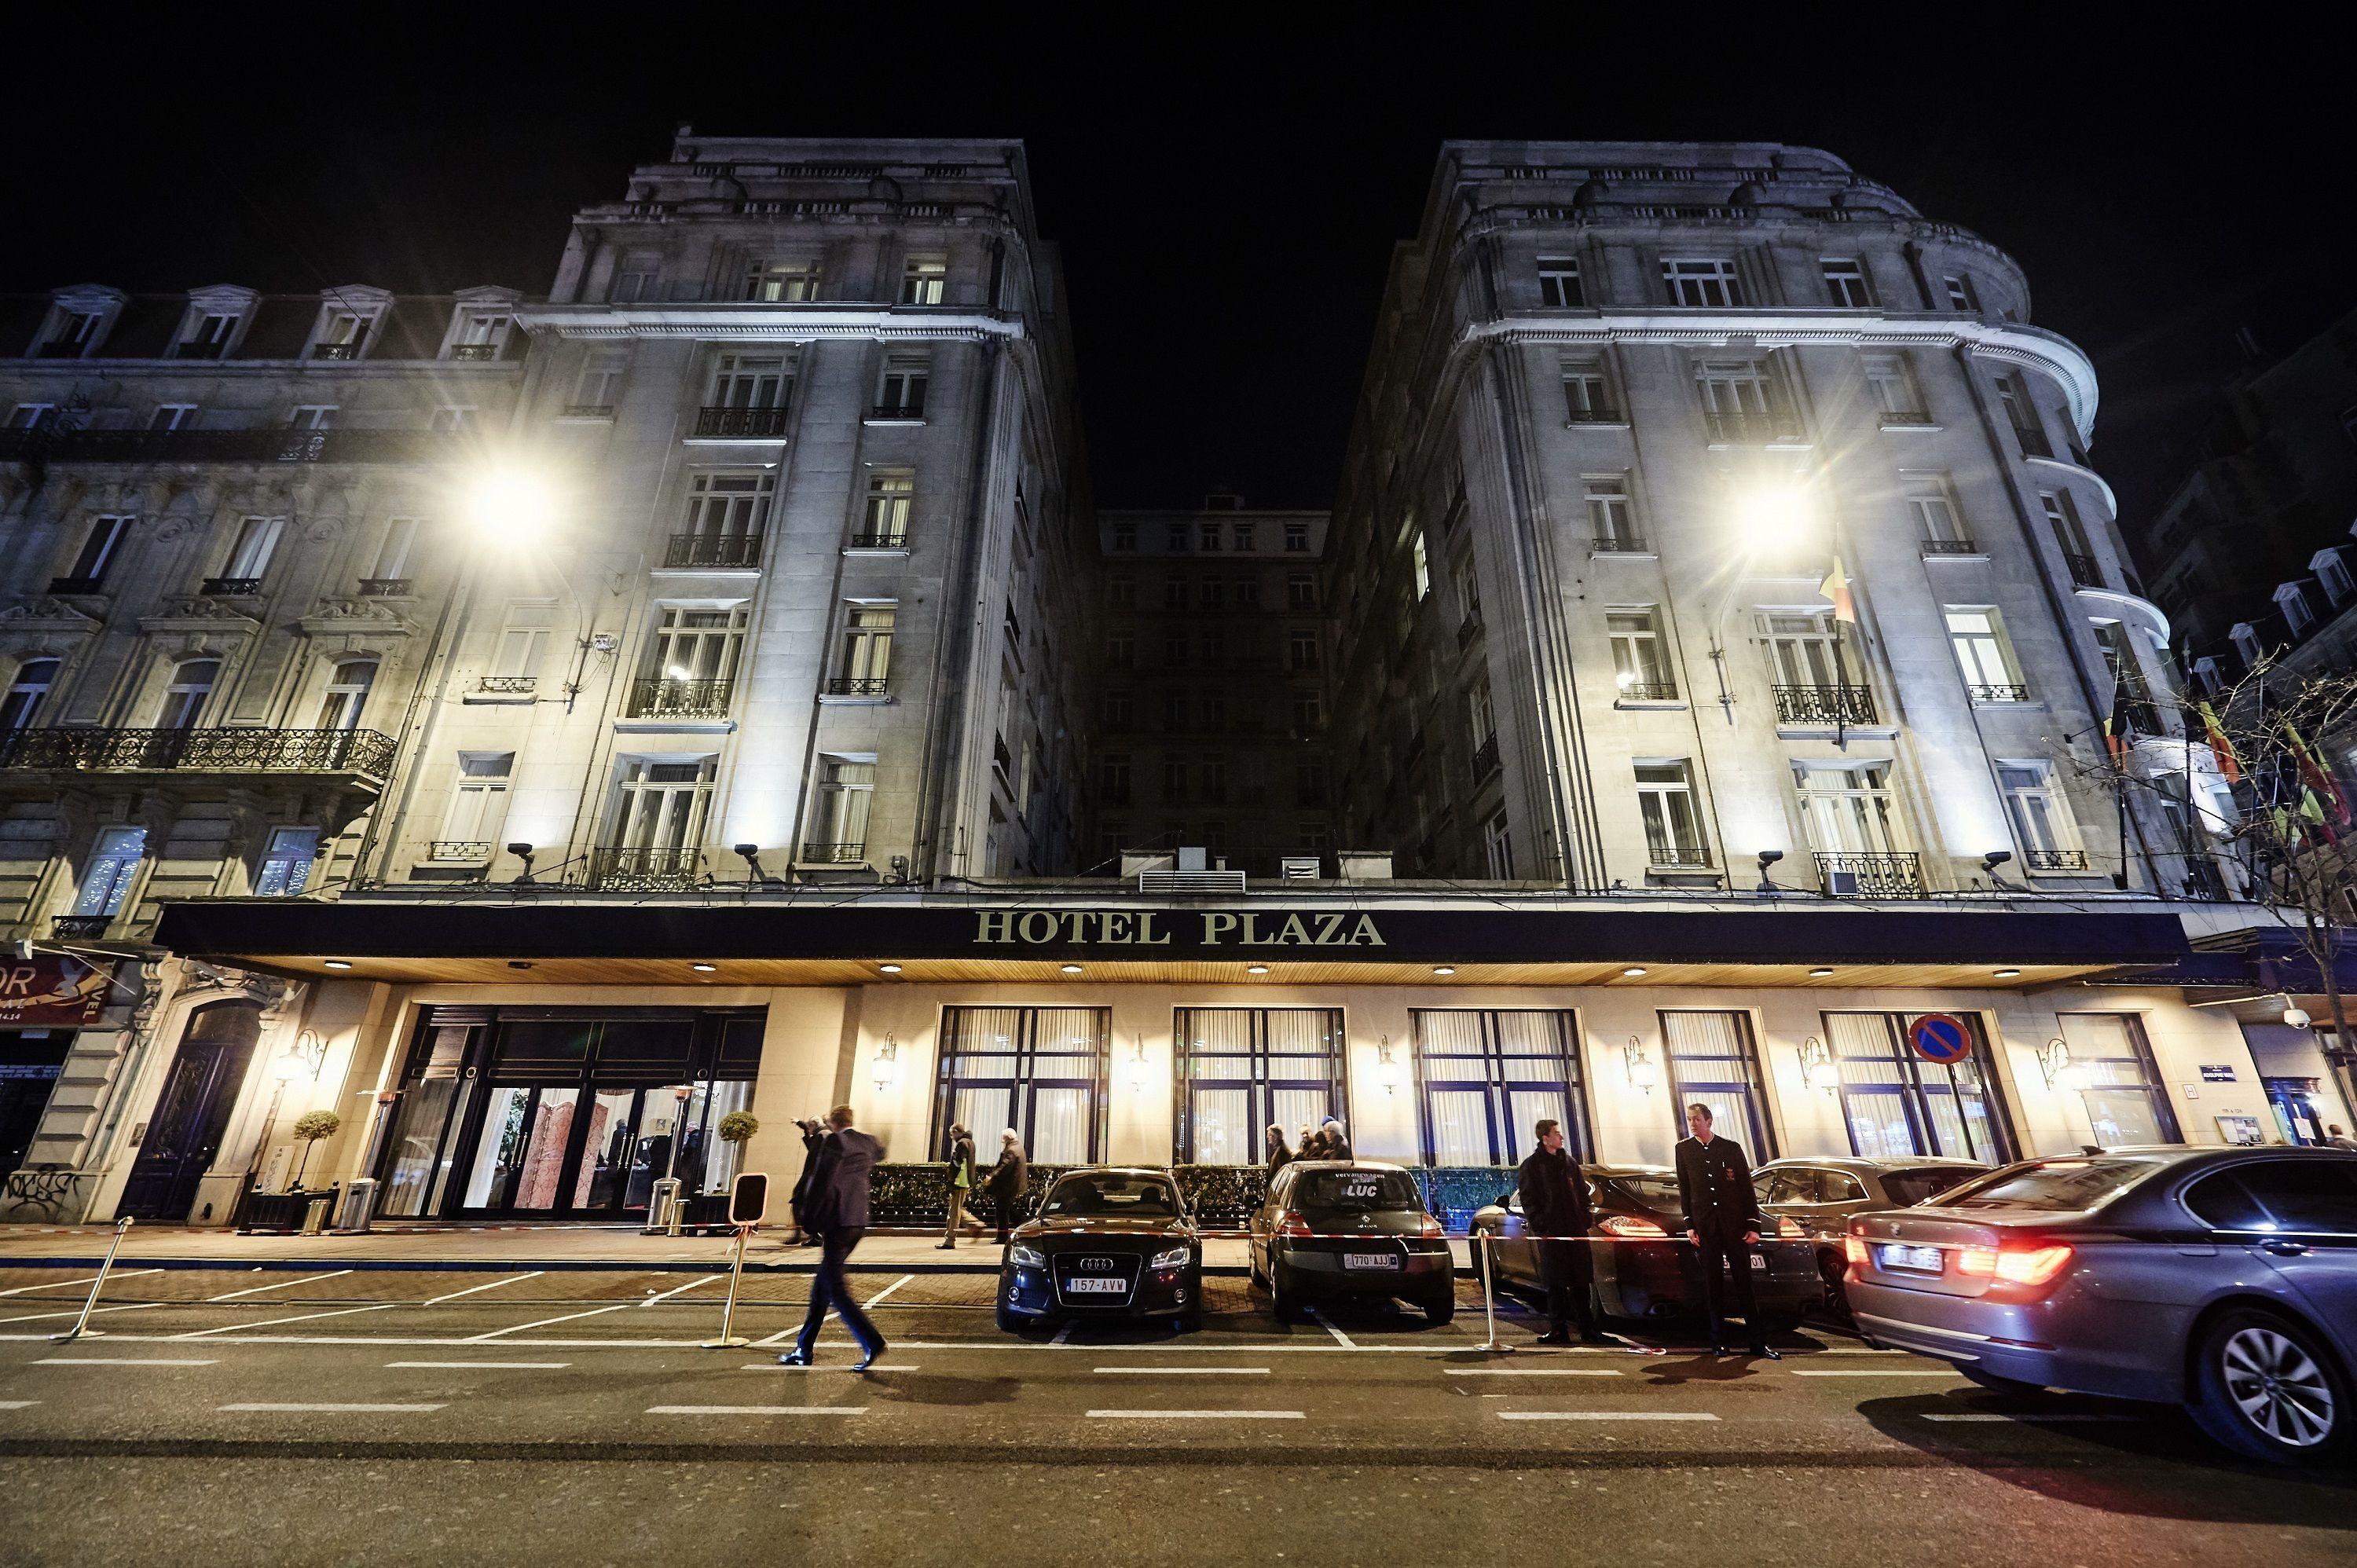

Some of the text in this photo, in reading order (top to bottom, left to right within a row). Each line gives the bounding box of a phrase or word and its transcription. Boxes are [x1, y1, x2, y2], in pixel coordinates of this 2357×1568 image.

[973, 911, 1387, 946] HOTEL PLAZA
[1347, 1185, 1377, 1197] LUC
[1073, 1279, 1124, 1291] 157-AVW
